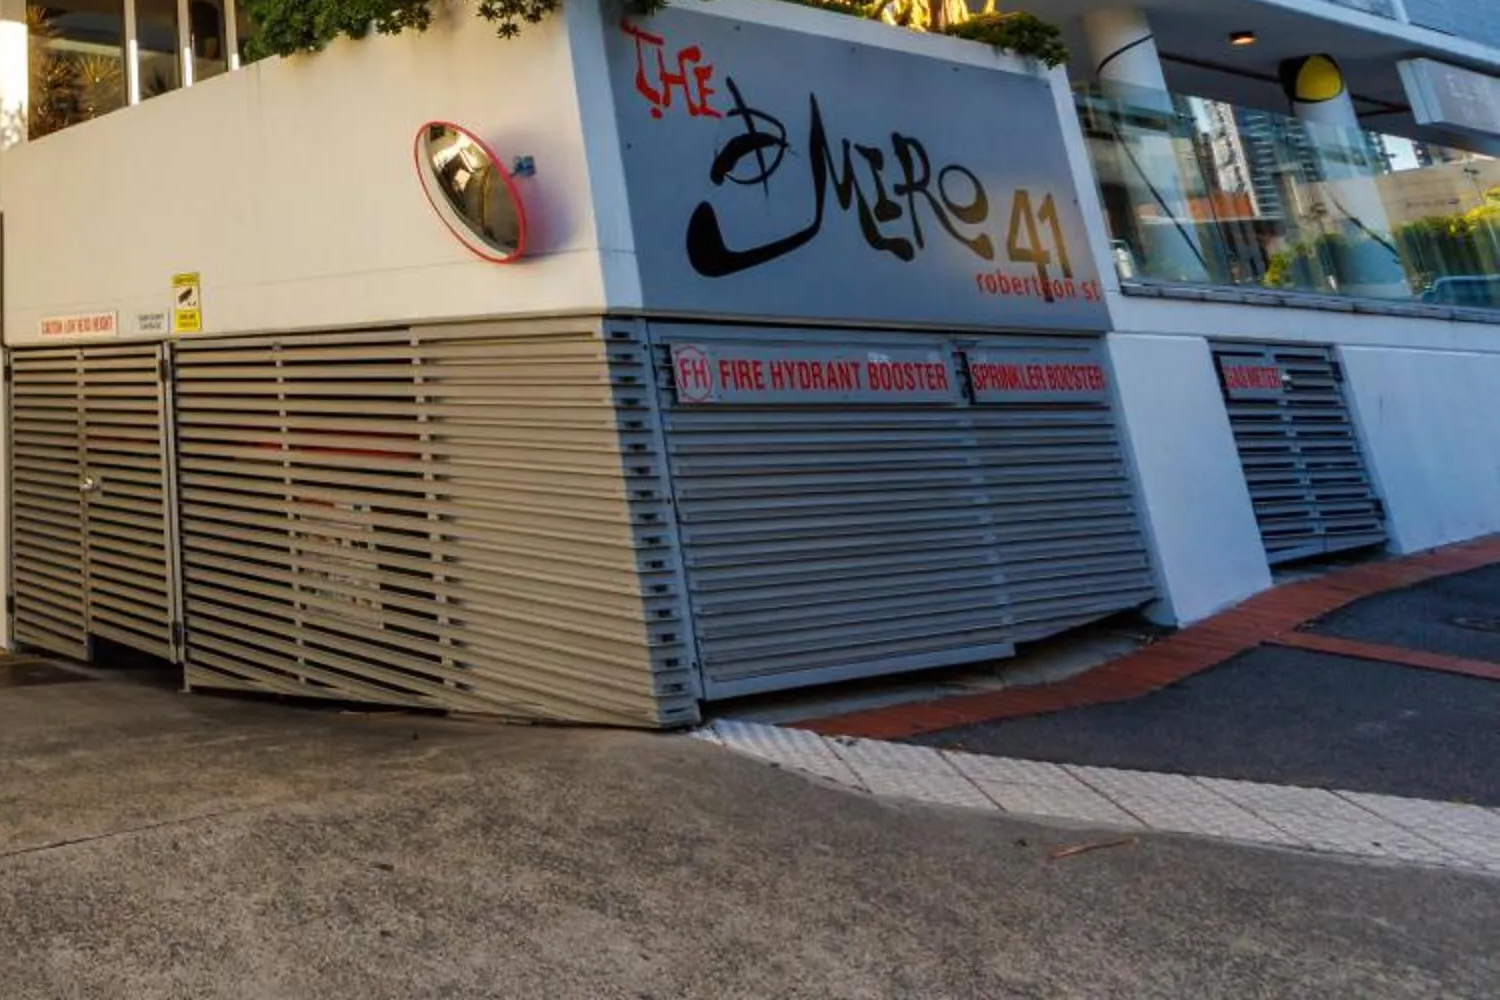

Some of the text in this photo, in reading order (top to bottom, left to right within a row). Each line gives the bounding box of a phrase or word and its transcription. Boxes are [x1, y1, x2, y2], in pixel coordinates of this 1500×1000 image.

[619, 18, 723, 119] THE
[686, 91, 994, 278] MIRO
[1007, 189, 1072, 302] 41
[678, 357, 710, 390] FH
[718, 359, 949, 392] FIRE HYDRANT BOOSTER
[972, 362, 1106, 391] SPRINKLER BOOSTER
